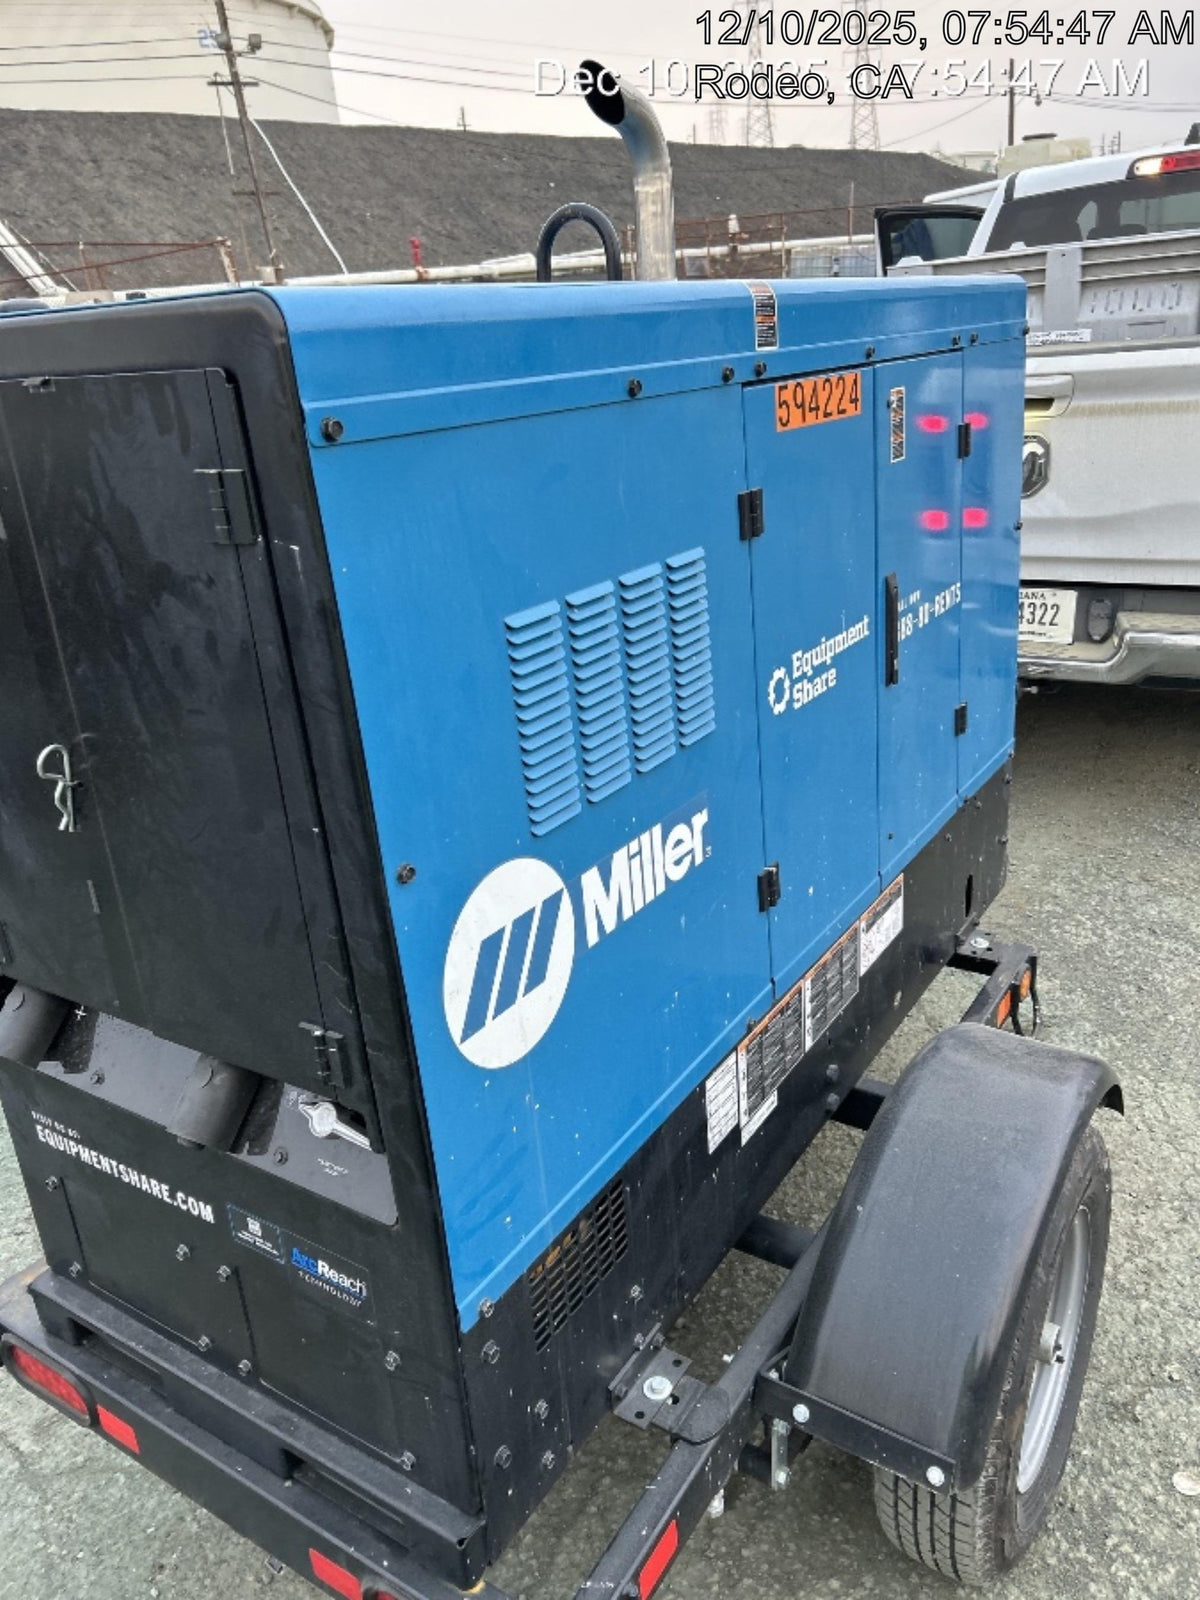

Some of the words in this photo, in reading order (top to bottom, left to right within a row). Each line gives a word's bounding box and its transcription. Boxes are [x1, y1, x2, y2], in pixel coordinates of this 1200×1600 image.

[778, 373, 859, 428] 594224
[791, 614, 870, 680] Equipment
[792, 667, 837, 710] Share
[581, 807, 709, 949] Miller
[35, 1124, 216, 1225] EQUIPMENTSHARE.COM
[291, 1247, 368, 1298] ArcReach
